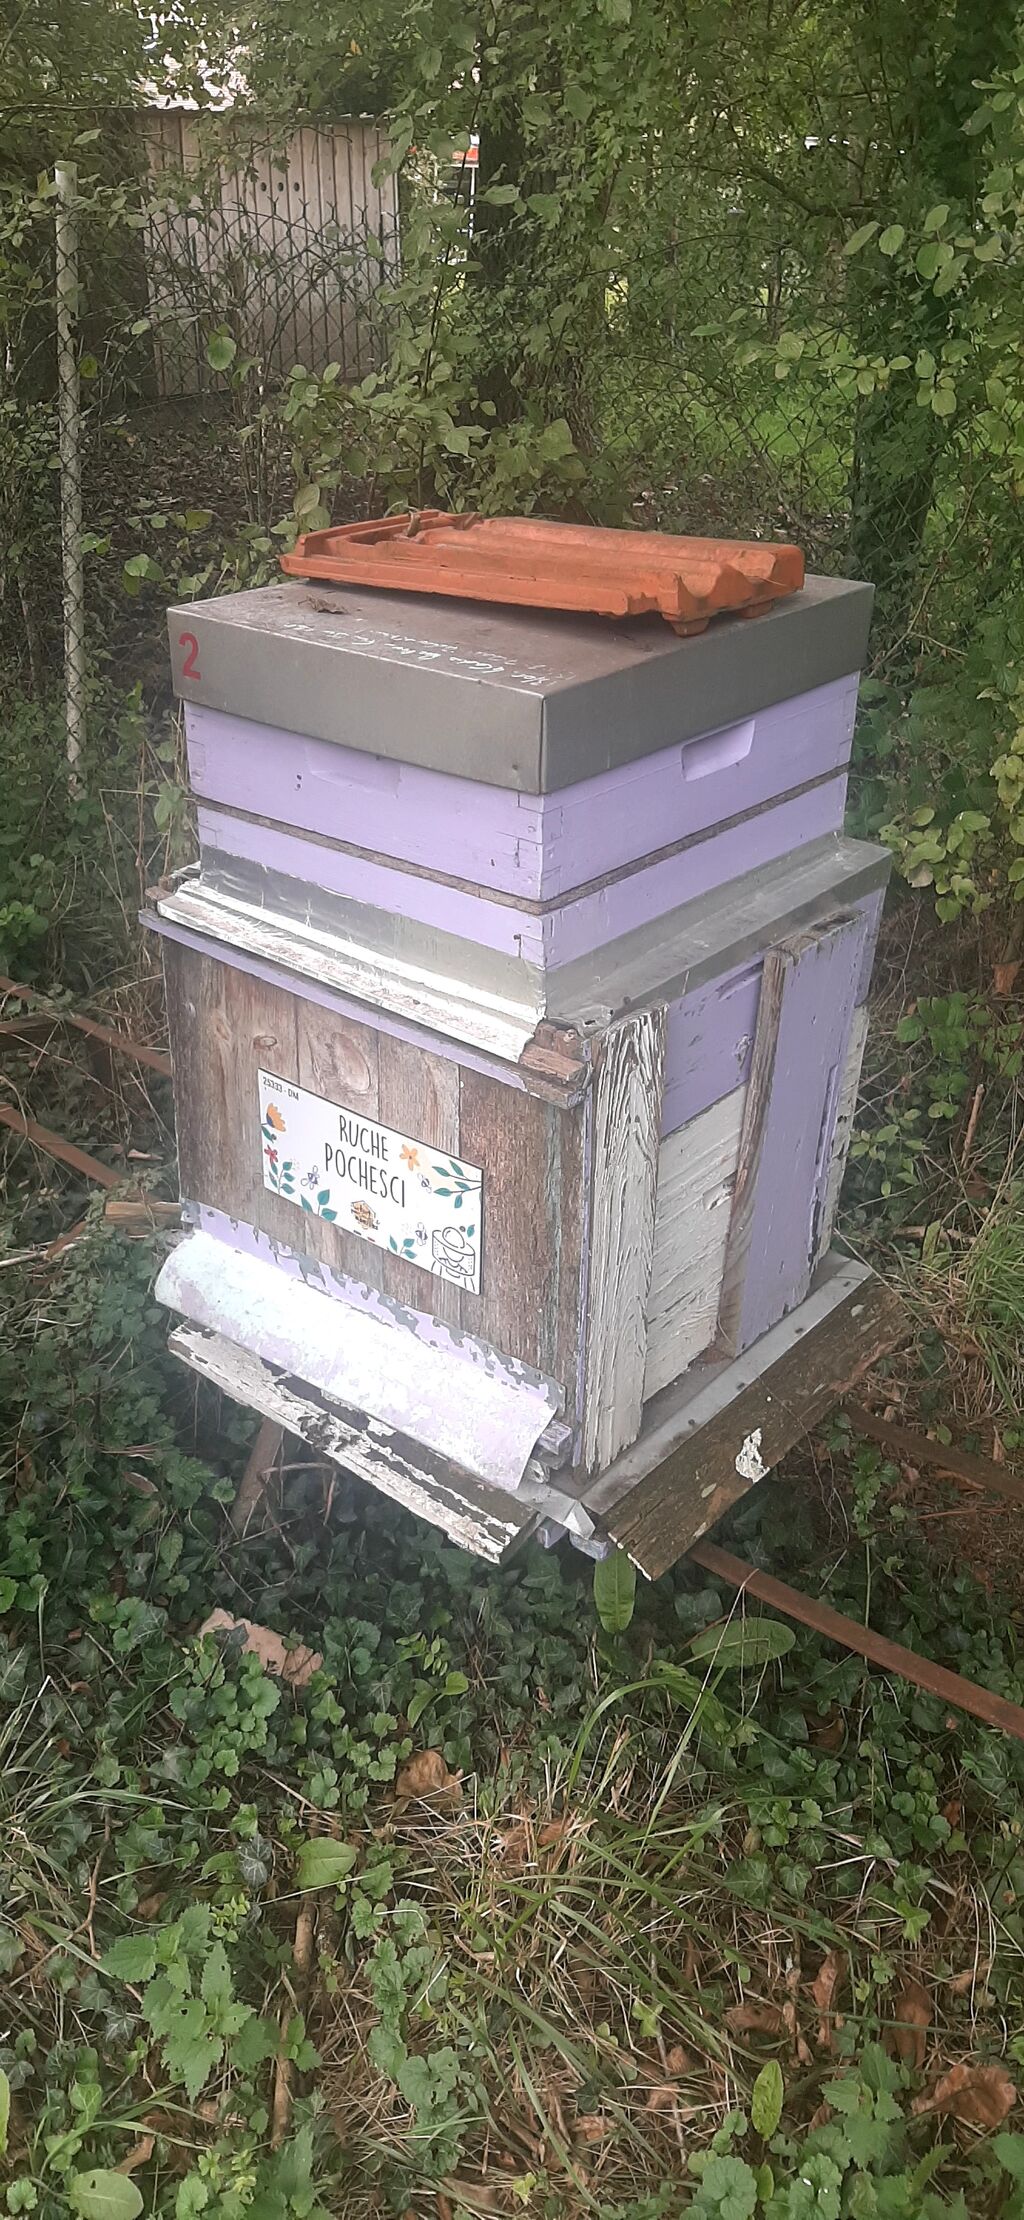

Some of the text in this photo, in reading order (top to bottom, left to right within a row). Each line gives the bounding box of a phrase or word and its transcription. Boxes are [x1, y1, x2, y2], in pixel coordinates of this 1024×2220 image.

[178, 632, 201, 681] 2
[339, 1114, 389, 1162] RUCHE
[325, 1142, 405, 1208] POCHESCI
